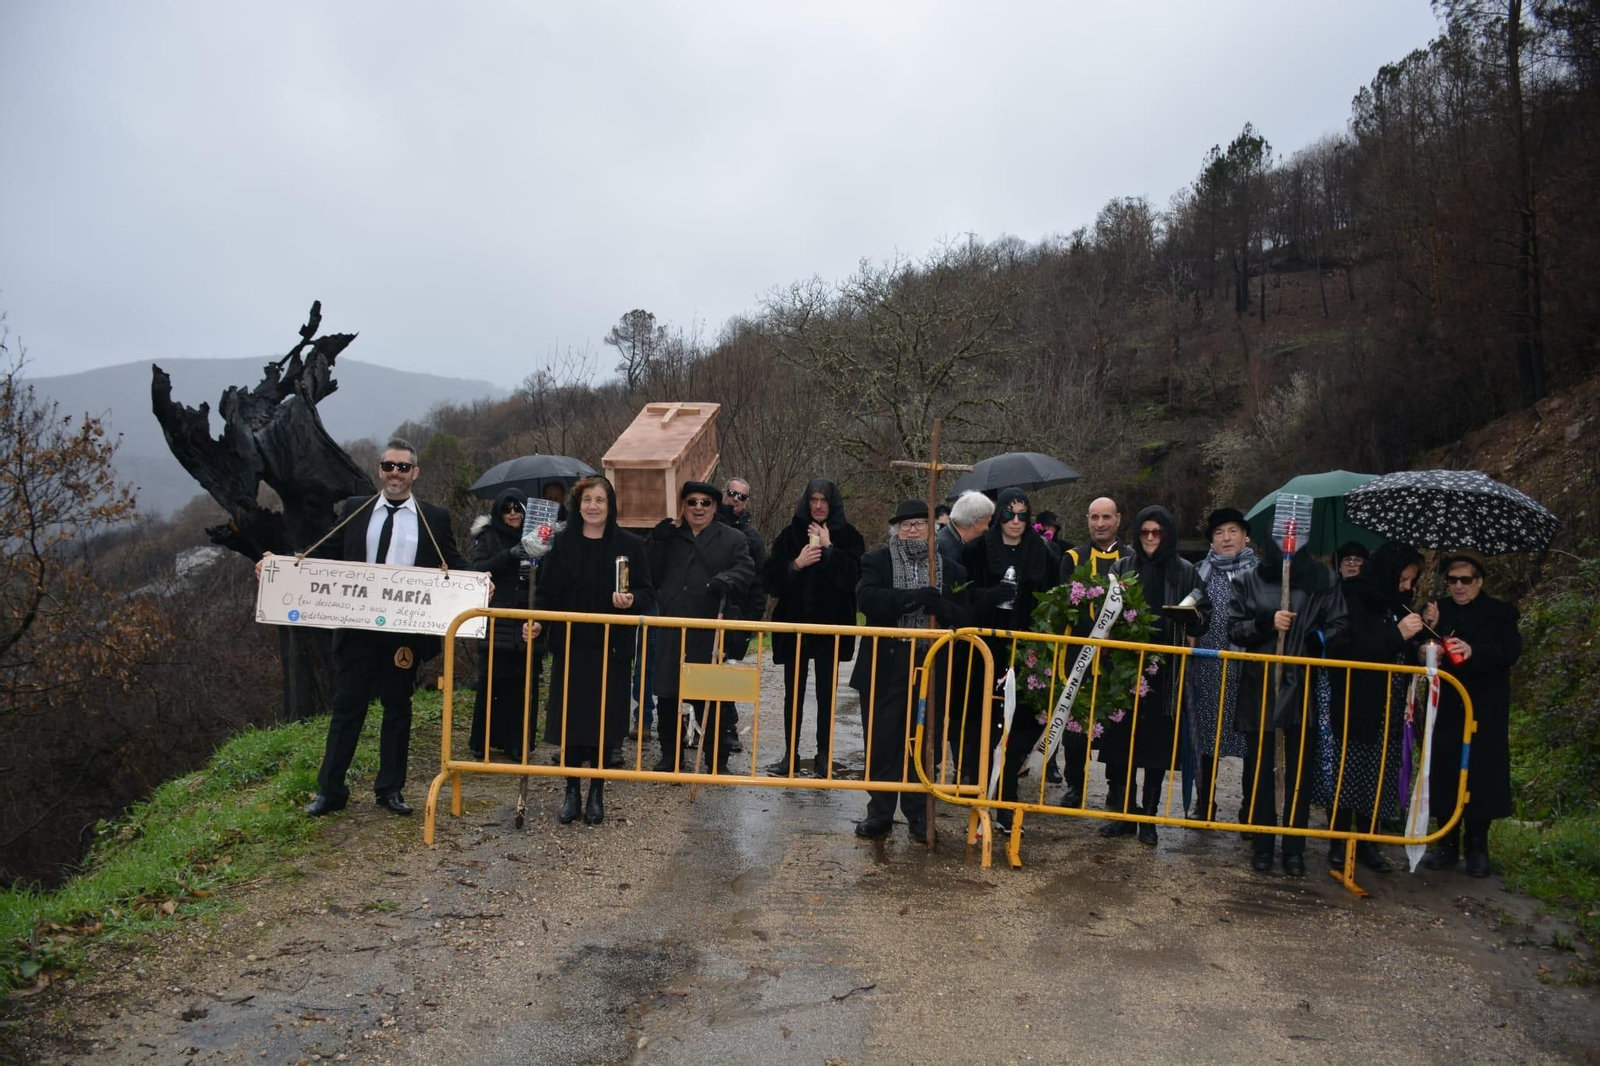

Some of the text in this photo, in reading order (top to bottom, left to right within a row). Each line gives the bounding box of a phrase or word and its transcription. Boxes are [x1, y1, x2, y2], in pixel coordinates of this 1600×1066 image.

[299, 562, 375, 582] Funeraria
[391, 570, 475, 591] Crematorio
[282, 592, 294, 606] O
[1110, 586, 1122, 603] OS
[1098, 609, 1115, 630] TEUS
[1065, 677, 1078, 700] NON
